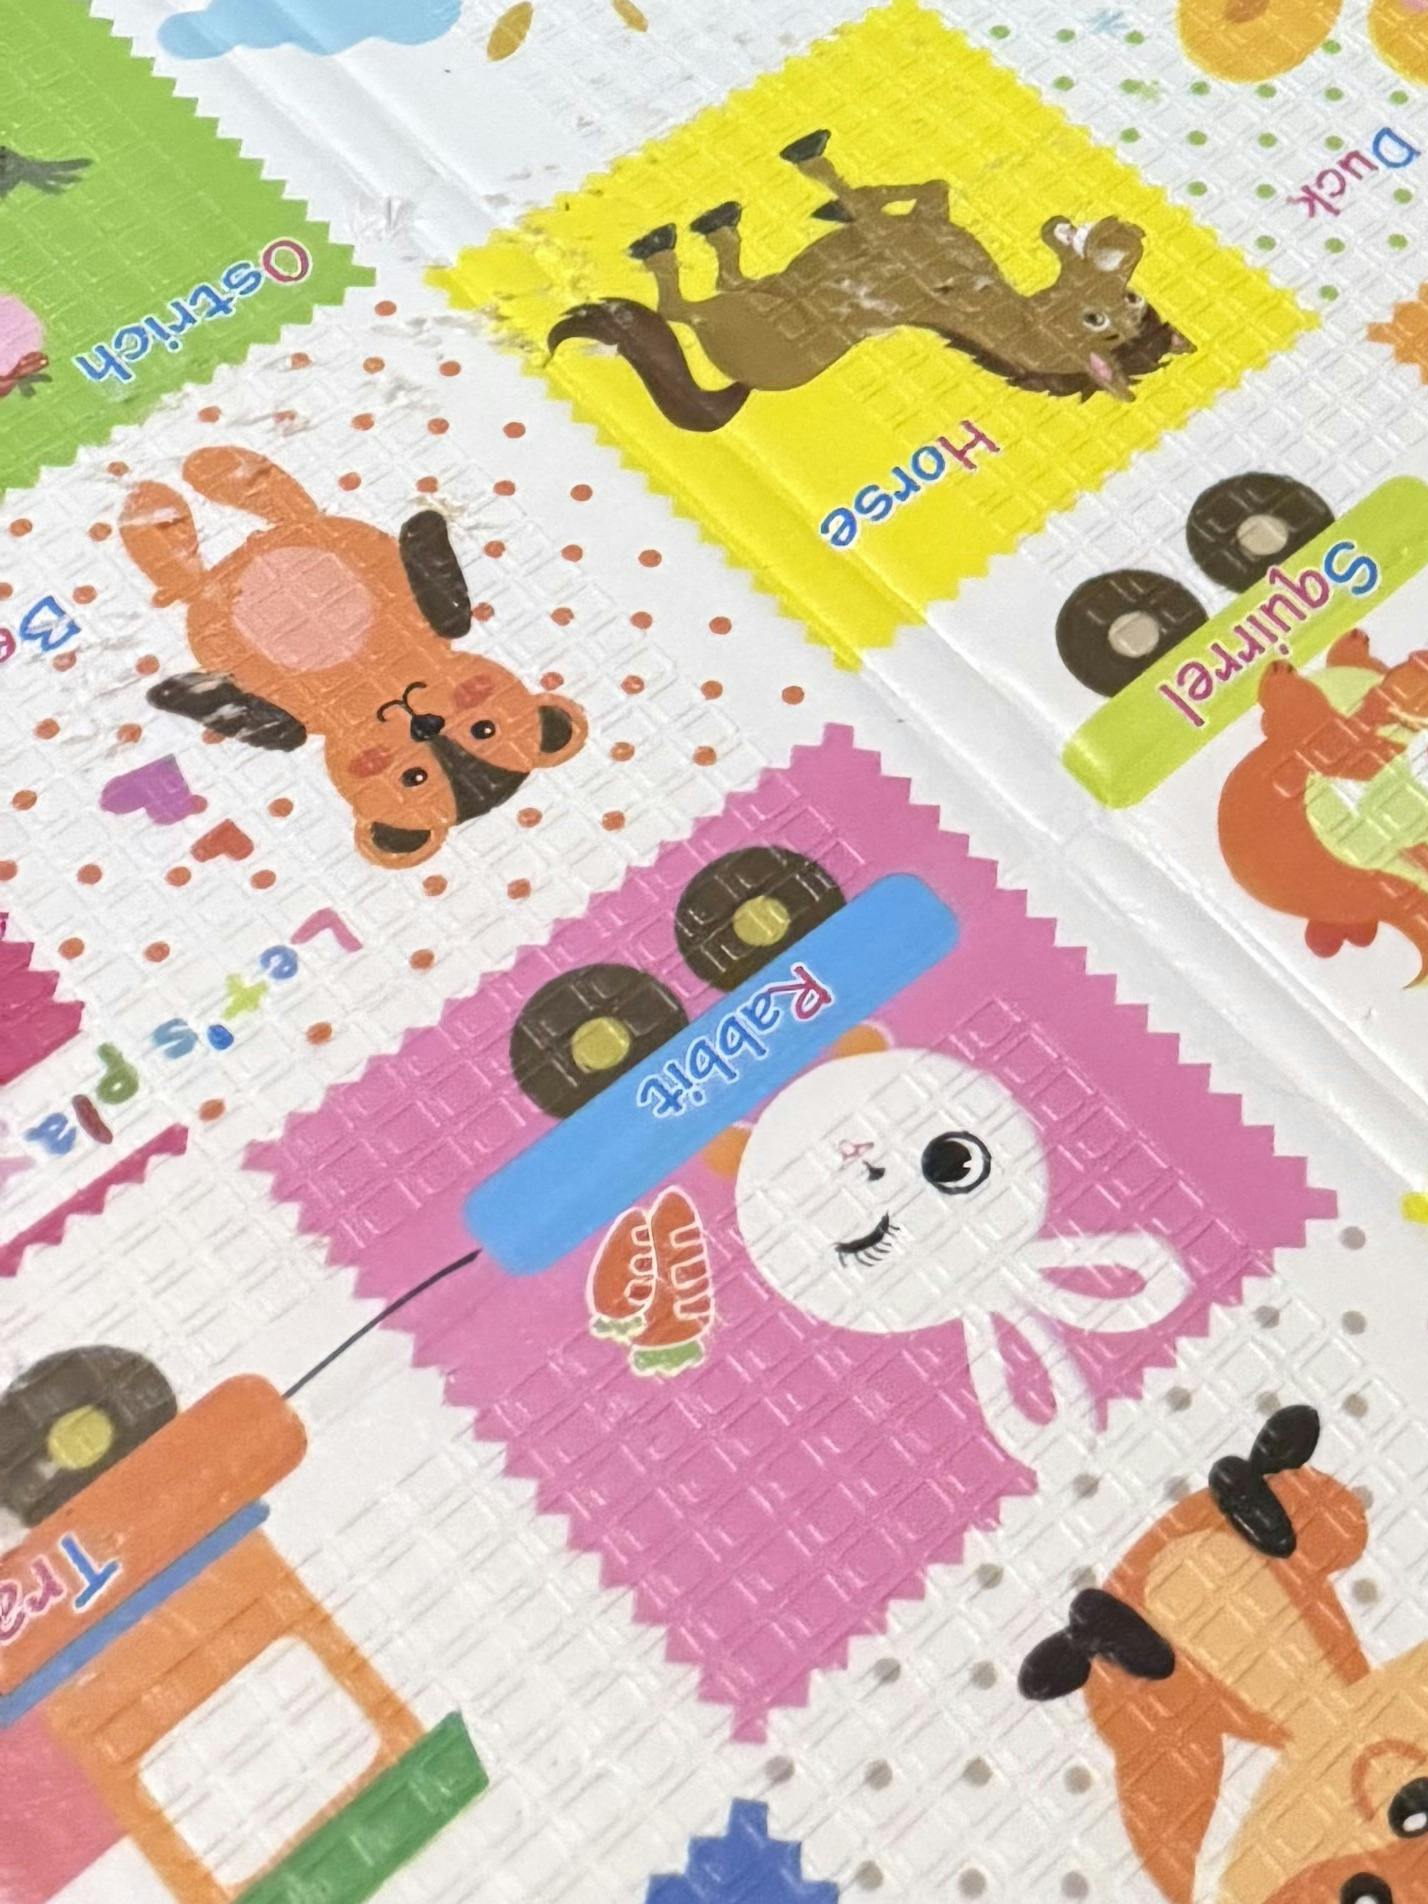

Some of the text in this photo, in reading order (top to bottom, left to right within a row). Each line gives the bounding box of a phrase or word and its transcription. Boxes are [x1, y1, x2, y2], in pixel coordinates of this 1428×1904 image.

[1298, 124, 1422, 220] Duck
[73, 237, 312, 383] Ostrich
[818, 418, 1001, 551] Horse
[1157, 539, 1380, 728] Squirrel
[637, 965, 832, 1118] Rabbit
